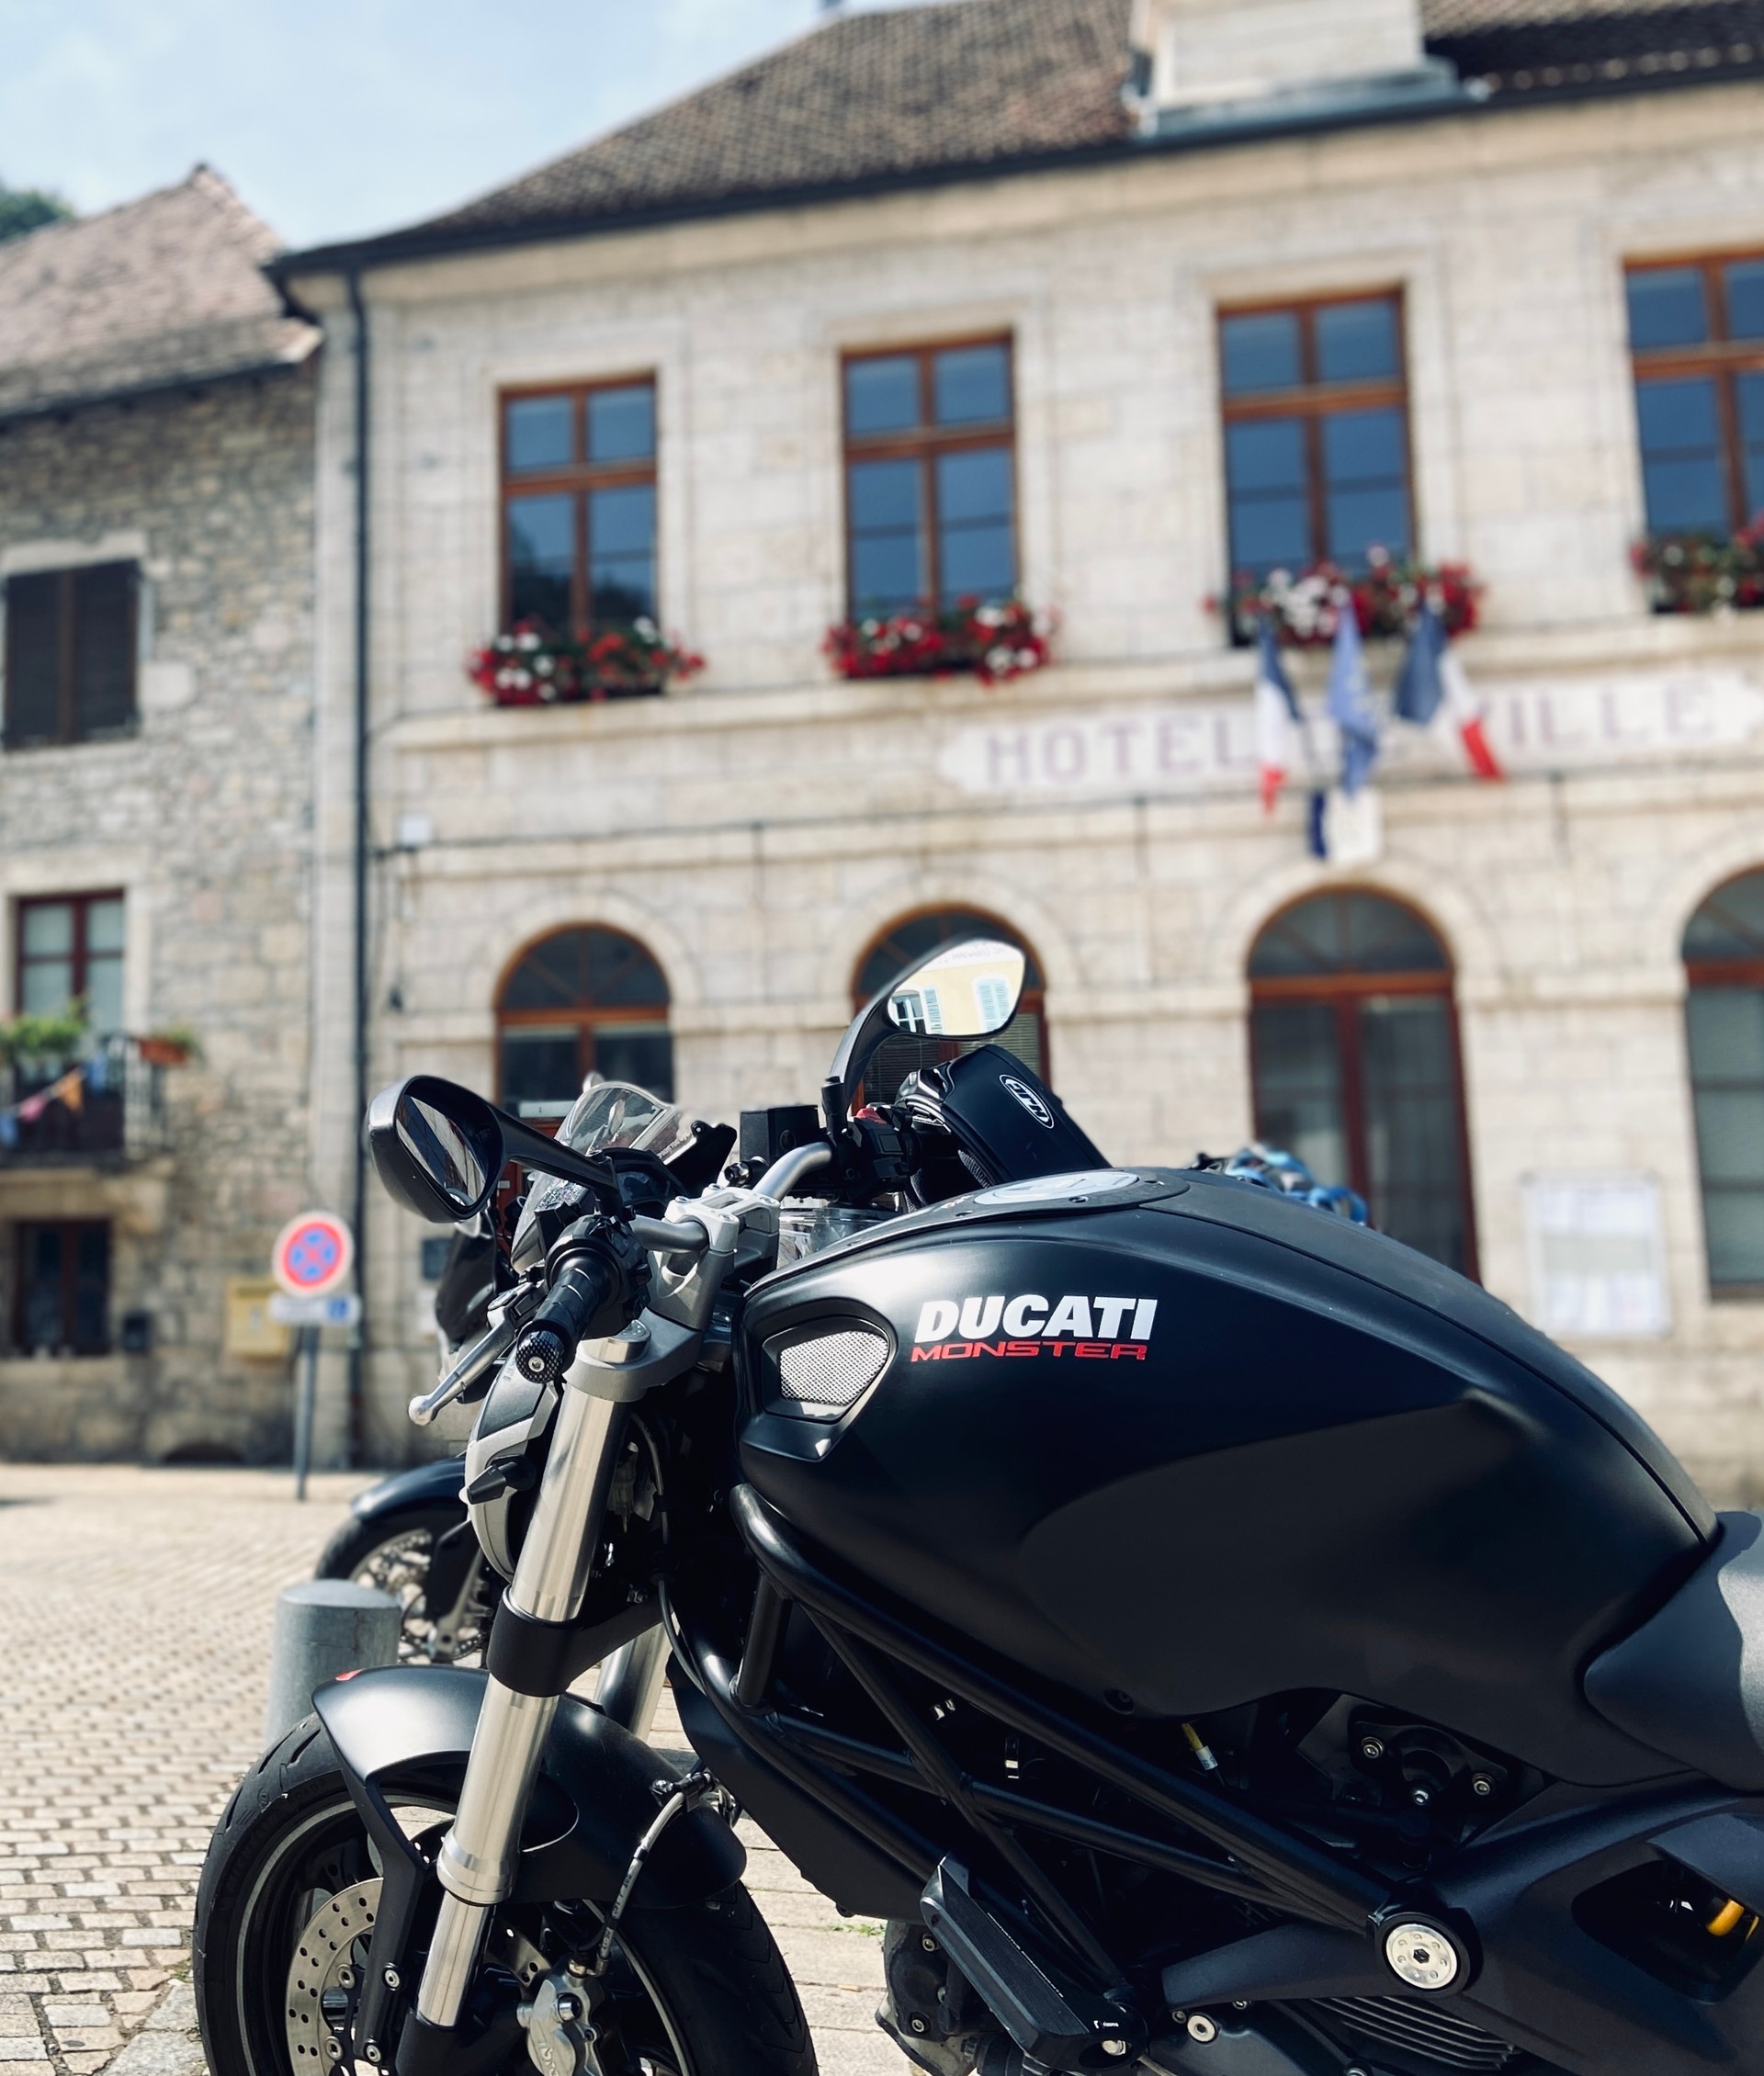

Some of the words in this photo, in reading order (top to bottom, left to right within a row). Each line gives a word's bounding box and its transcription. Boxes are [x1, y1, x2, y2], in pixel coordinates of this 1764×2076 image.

[987, 713, 1256, 783] HOTEL
[1006, 1079, 1049, 1122] HJC
[914, 1294, 1158, 1343] DUCATI
[911, 1341, 1148, 1362] MONSTER
